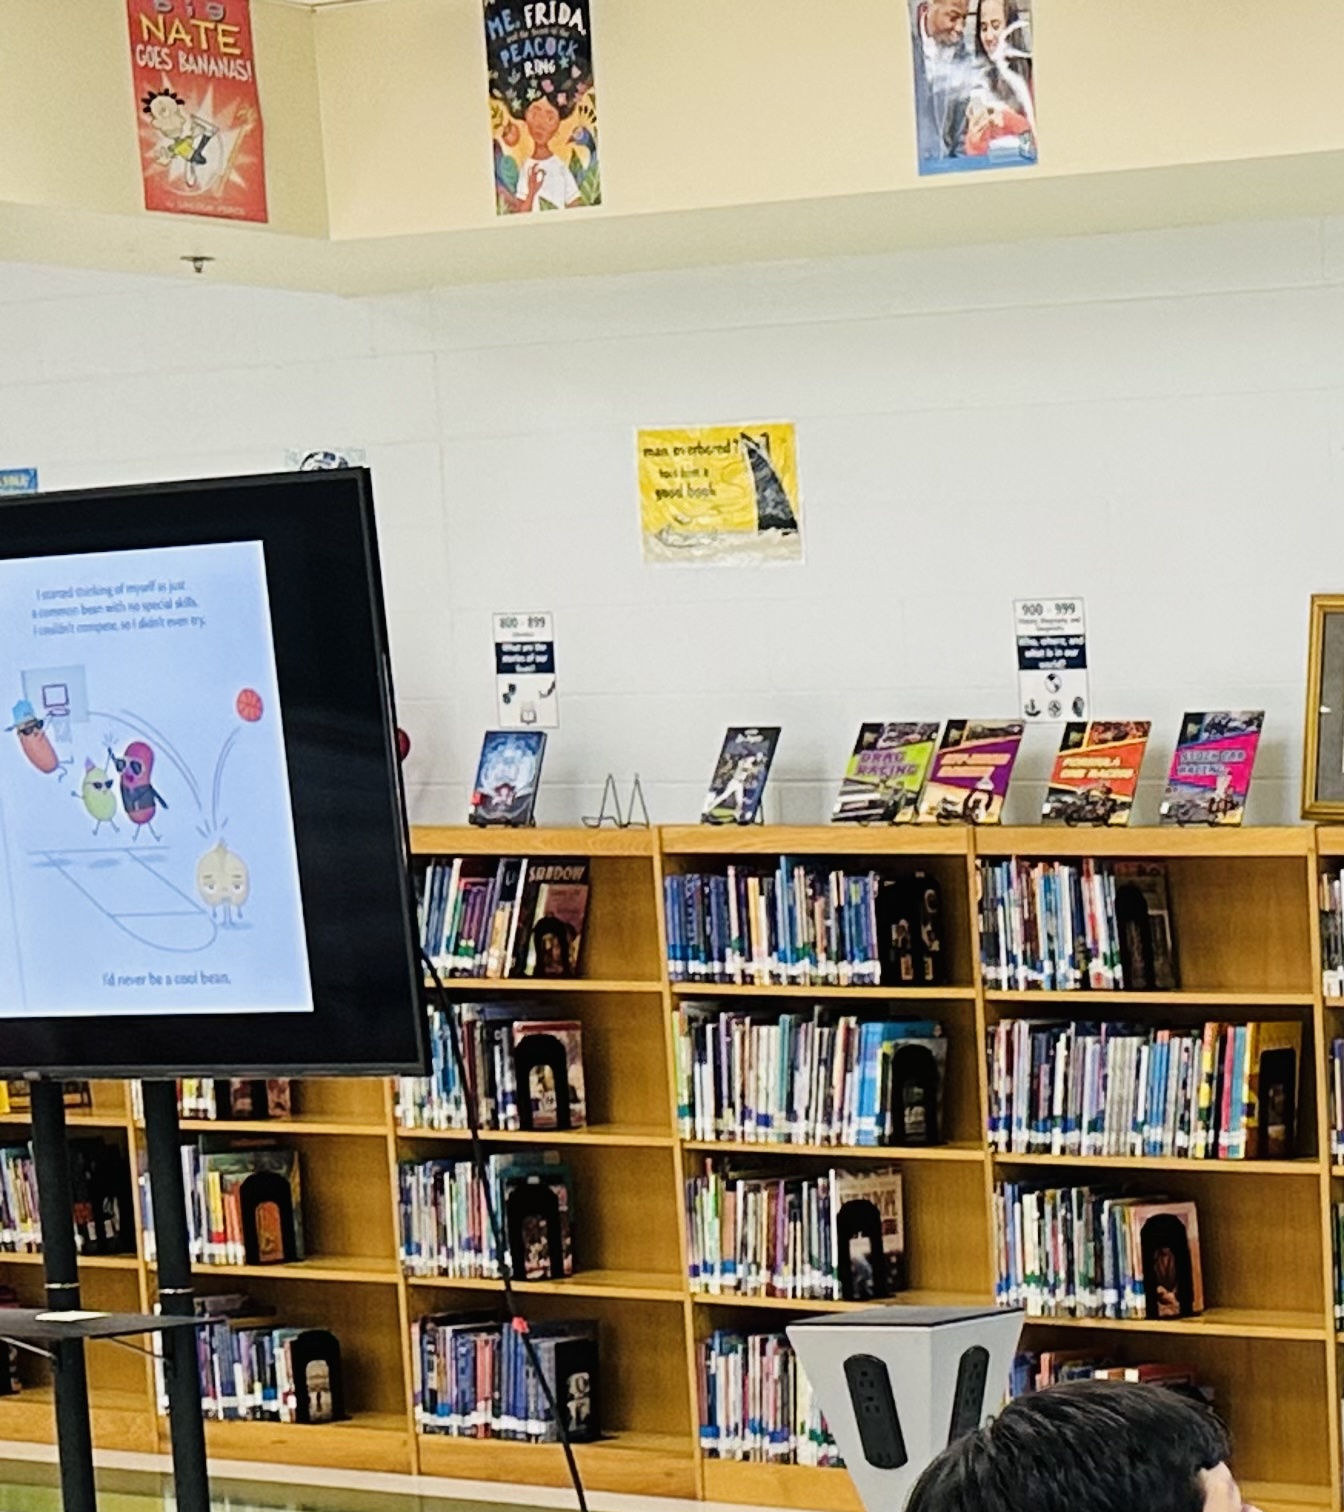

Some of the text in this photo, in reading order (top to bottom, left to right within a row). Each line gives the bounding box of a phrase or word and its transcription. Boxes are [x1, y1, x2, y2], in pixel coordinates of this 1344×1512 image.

[139, 13, 242, 55] NATE
[500, 37, 578, 68] PEACOCK
[136, 44, 252, 81] GOES BANANAS!
[524, 59, 556, 77] RING
[1022, 602, 1076, 615] 900 999
[860, 751, 905, 762] DRAG
[857, 764, 917, 775] RACING
